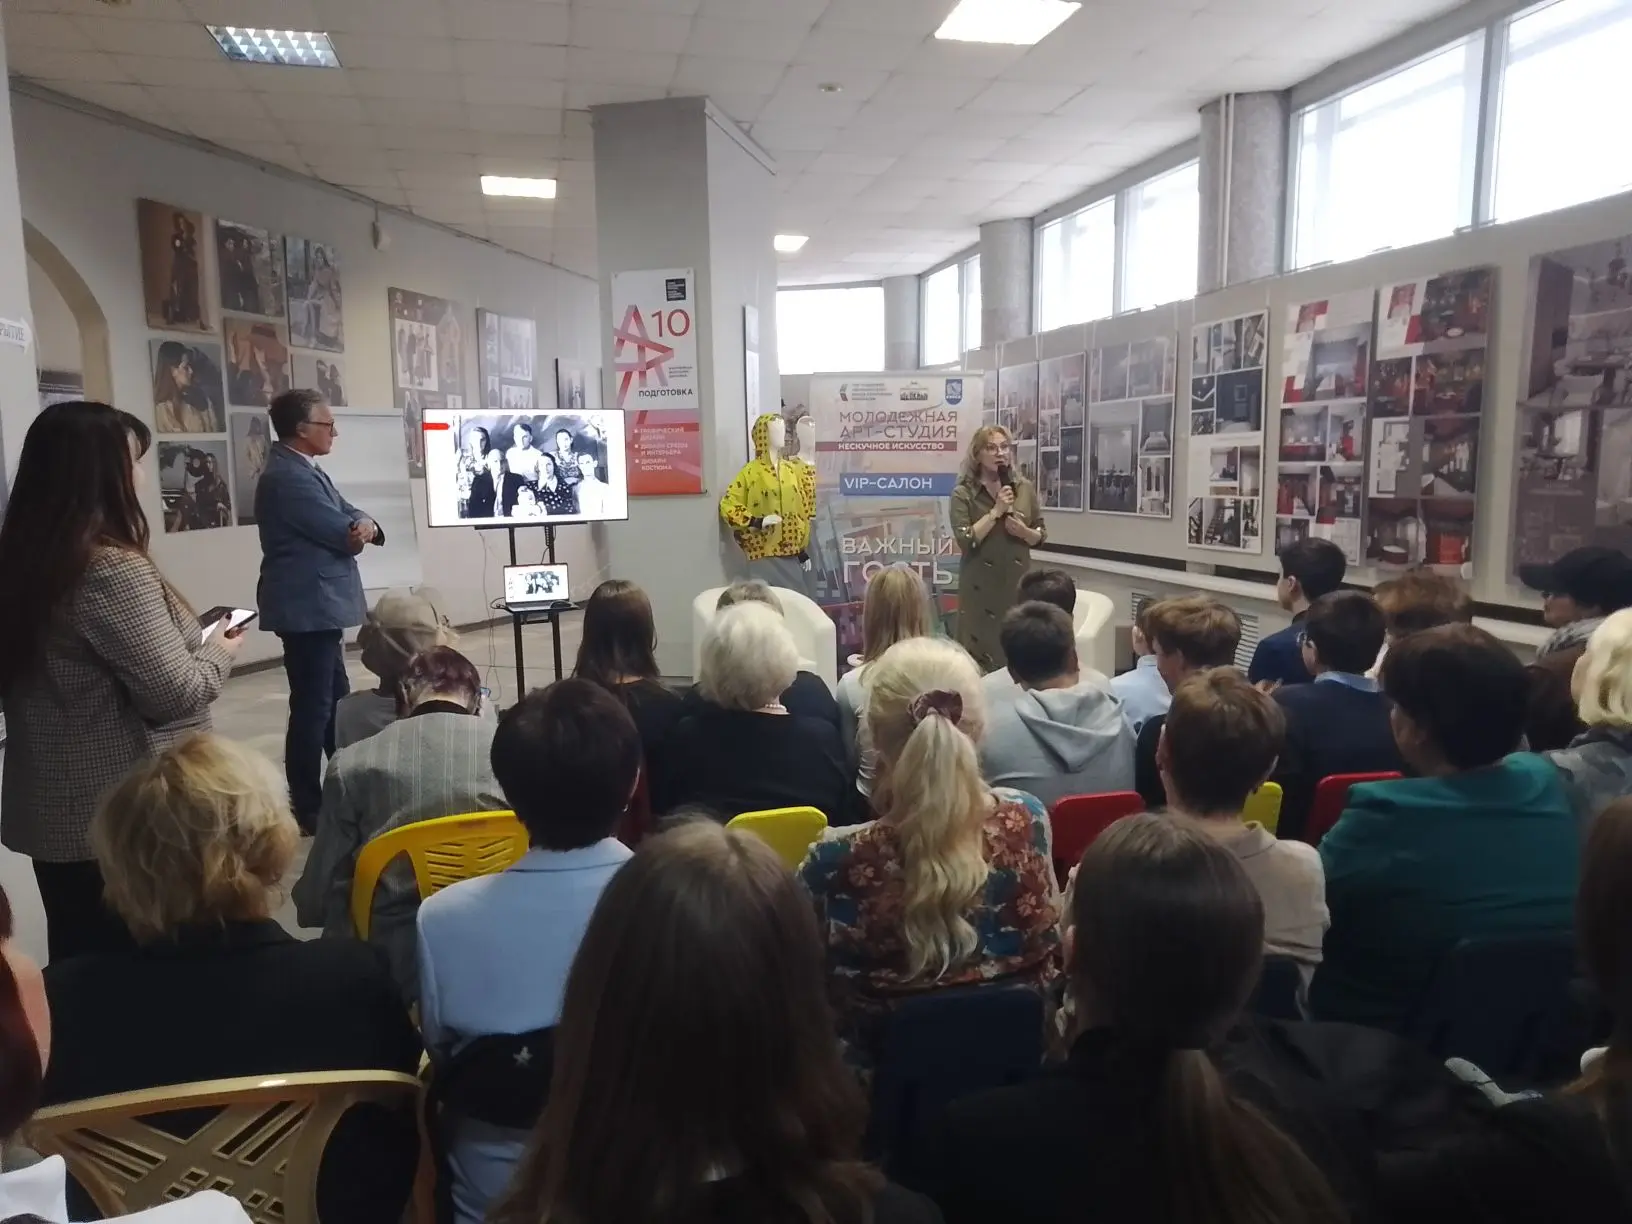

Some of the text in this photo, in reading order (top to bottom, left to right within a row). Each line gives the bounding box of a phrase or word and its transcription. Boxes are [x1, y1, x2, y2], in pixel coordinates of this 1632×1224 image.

[638, 388, 694, 398] ПОДГОТОВКА
[839, 410, 958, 424] МОЛОДЕЖНАЯ
[839, 425, 957, 439] АРТ-СТУДИЯ
[838, 442, 945, 451] НЕСКУЧНОЕ ИСКУССТВО
[844, 476, 933, 490] VIP-САЛОН
[841, 535, 953, 555] ВАЖНЫЙ
[843, 560, 953, 585] ГОТЬ
